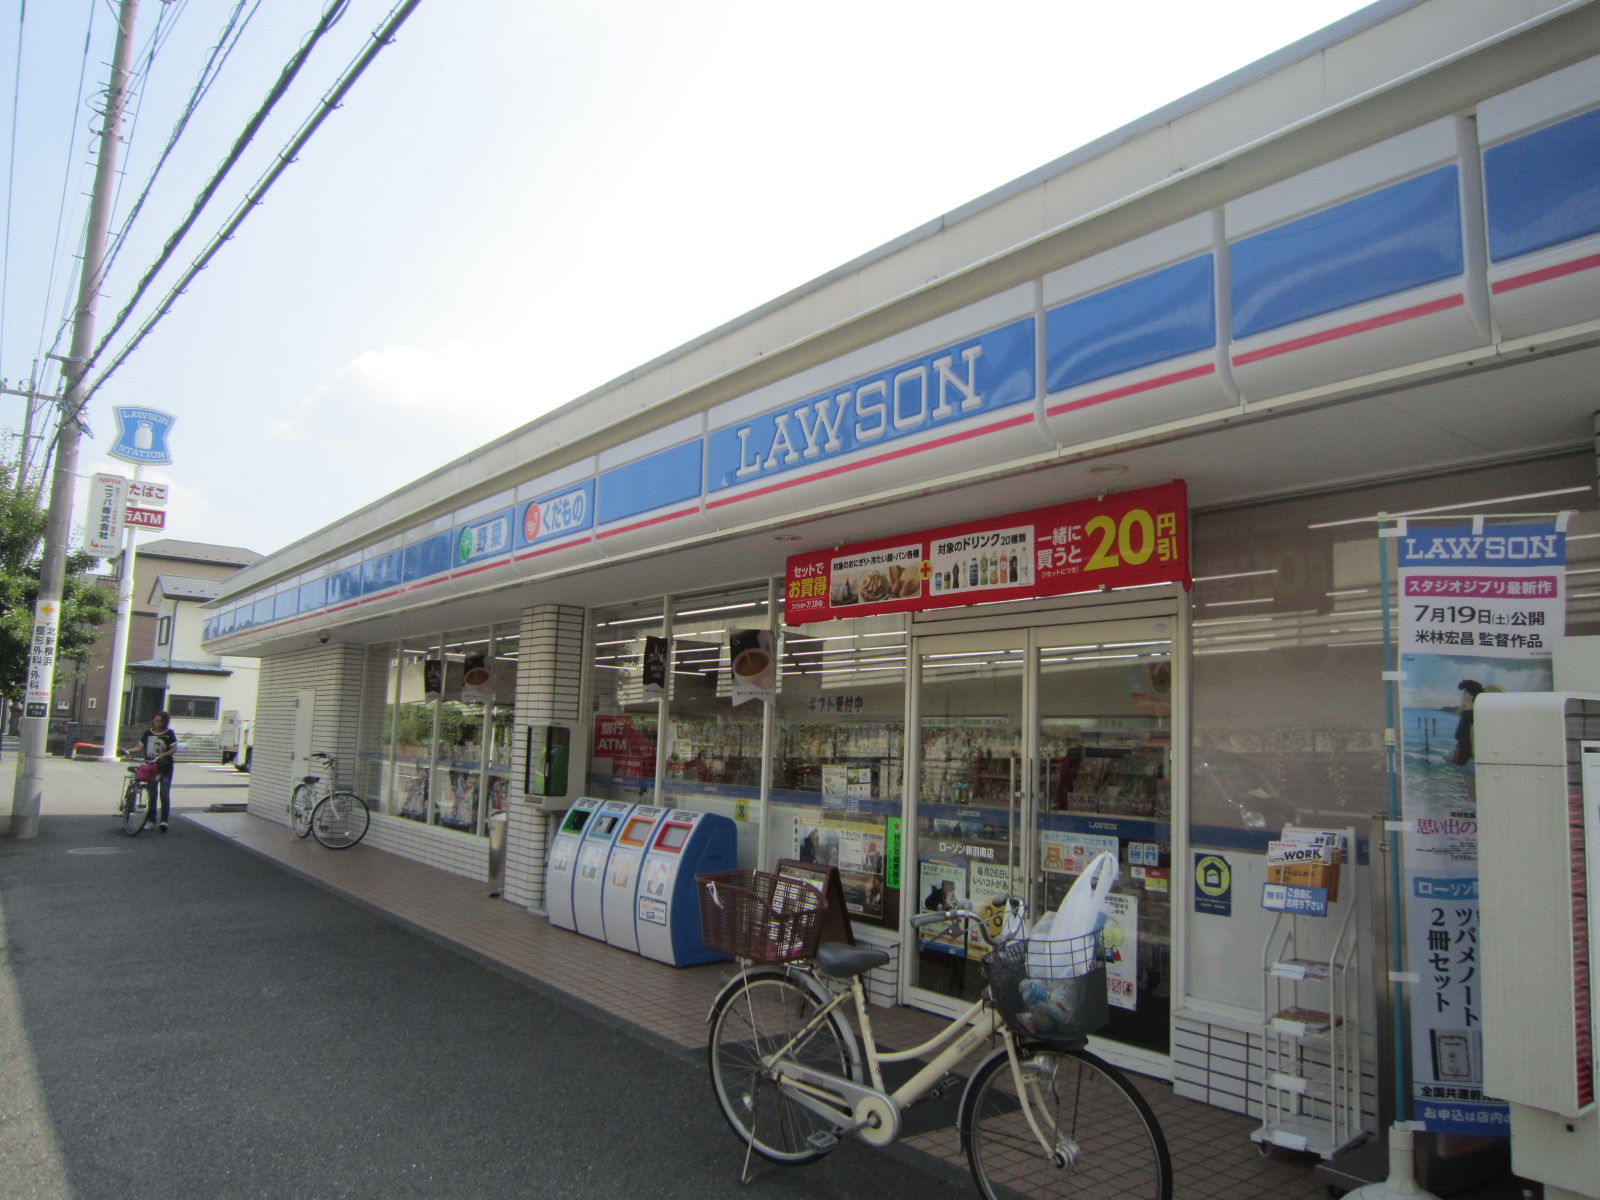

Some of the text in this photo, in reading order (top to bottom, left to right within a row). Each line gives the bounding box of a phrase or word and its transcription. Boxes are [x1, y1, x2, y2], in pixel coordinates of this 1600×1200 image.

[122, 410, 170, 425] LAWSON
[737, 345, 982, 478] LAWSON
[118, 444, 165, 458] STATION
[129, 484, 166, 500] たばこ
[99, 485, 114, 540] ニッパ株式会社
[543, 494, 584, 532] くだもの
[475, 521, 503, 553] 野菜
[938, 533, 1027, 555] 対象のドリンク20種類
[1038, 525, 1082, 545] 一緒に
[1083, 508, 1178, 571] 20 円引
[1406, 535, 1558, 560] LAWSON
[1037, 545, 1082, 570] 買うと
[794, 562, 825, 578] セットで
[789, 576, 827, 598] お買得
[1408, 580, 1553, 595] スタジオジブリ最新作
[1414, 604, 1545, 626] 7月19日(土)公開
[43, 626, 56, 667] 北新横浜
[1415, 630, 1543, 649] 米林宏昌 監督作品
[29, 625, 46, 690] 整形外科・外科
[808, 695, 864, 713] ギフト受付中
[601, 722, 625, 735] 銀行
[597, 738, 627, 751] ATM
[1088, 821, 1118, 830] LAWSON
[1417, 818, 1478, 835] 思い出の
[940, 843, 995, 859] ローソン新羽南店
[1284, 849, 1323, 860] WORK
[1286, 898, 1323, 911] お持ち下さい
[1427, 907, 1451, 1013] 2冊セット
[1454, 908, 1479, 1027] ツバメノート
[1421, 1085, 1504, 1101] 全国共通前
